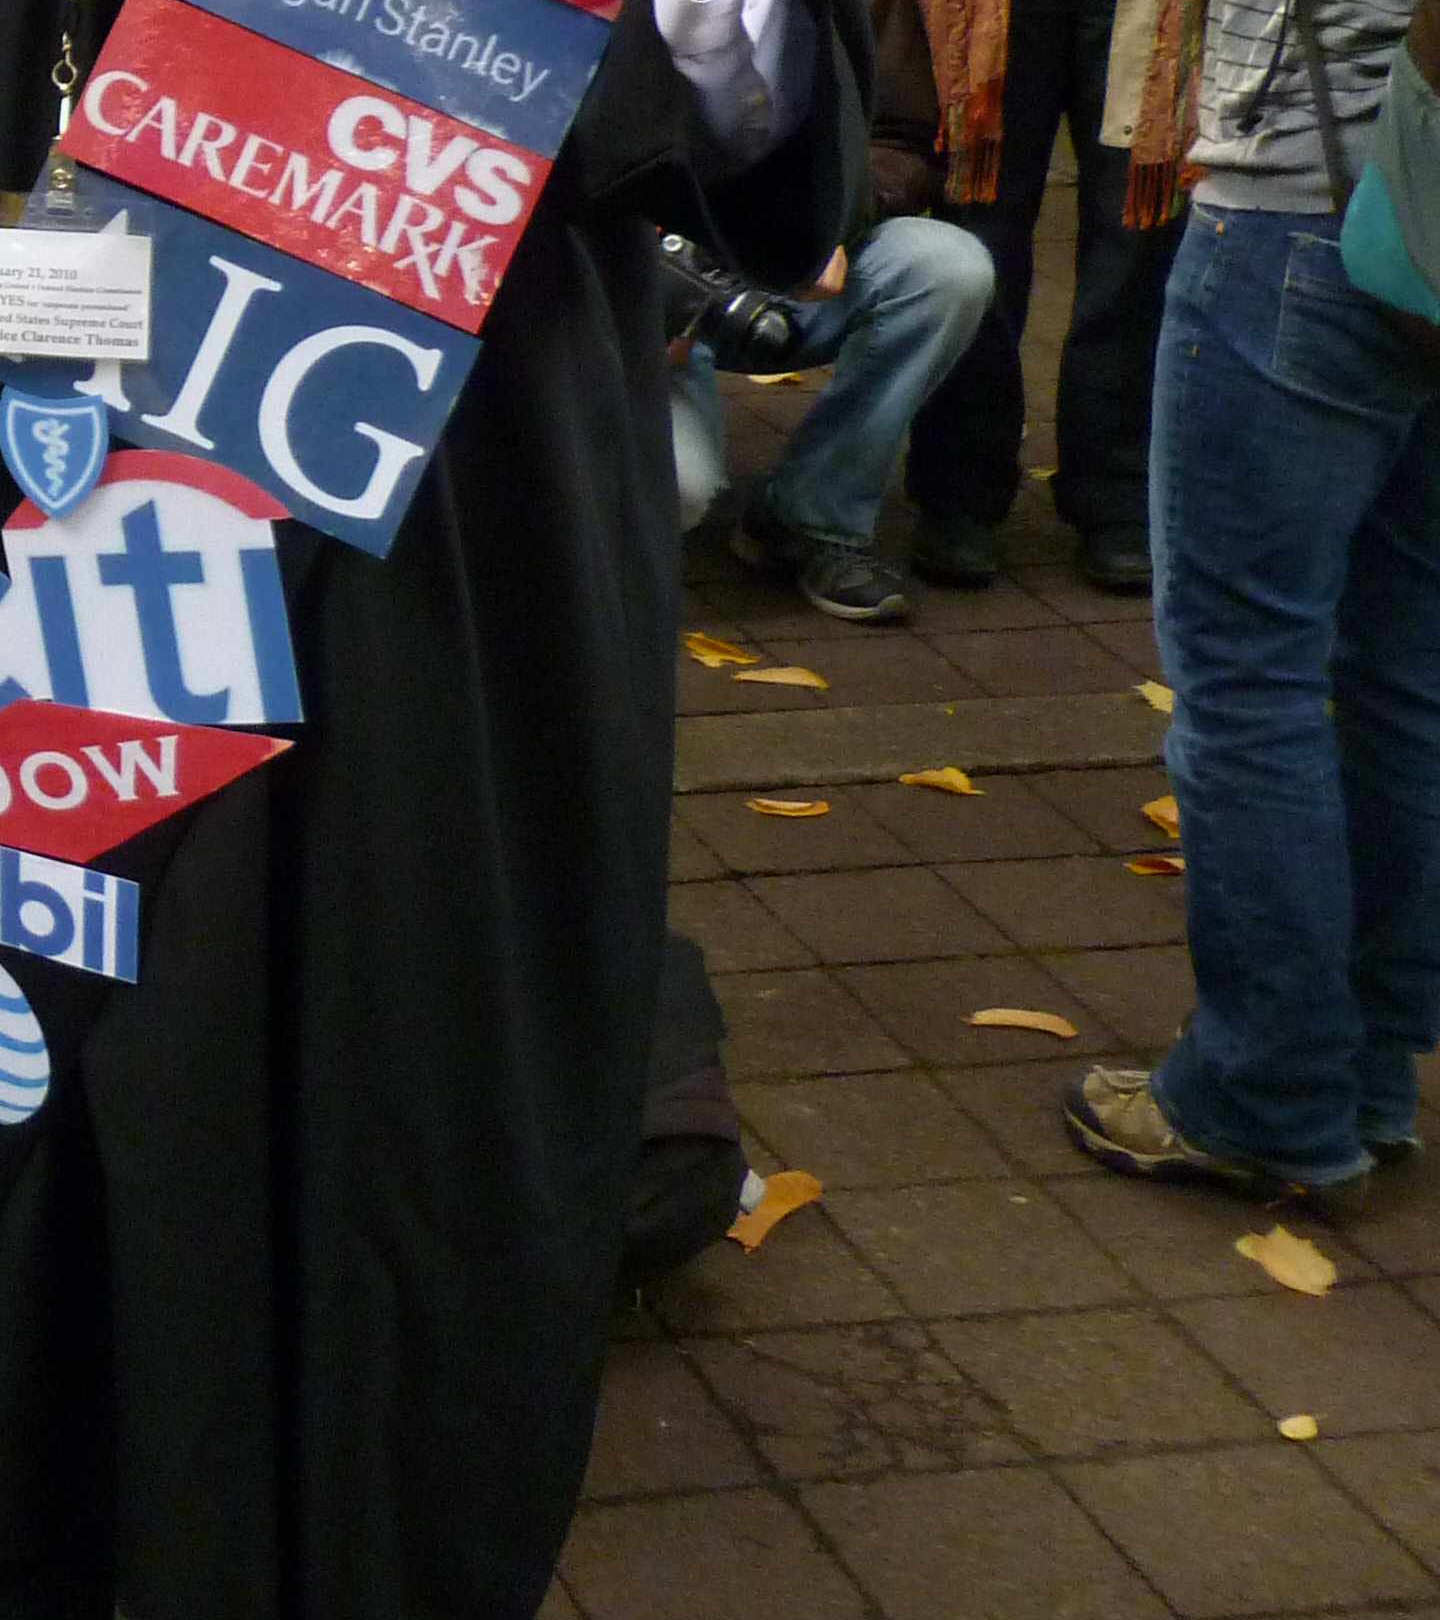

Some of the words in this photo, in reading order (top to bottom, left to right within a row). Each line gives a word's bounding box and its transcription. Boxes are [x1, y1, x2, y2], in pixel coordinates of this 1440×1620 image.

[81, 69, 500, 307] CAREMARK
[327, 94, 532, 226] CVS
[48, 268, 78, 280] 2010
[15, 312, 51, 326] States
[54, 314, 106, 331] Supreme
[22, 329, 81, 345] Clarence
[86, 333, 139, 347] Thomas
